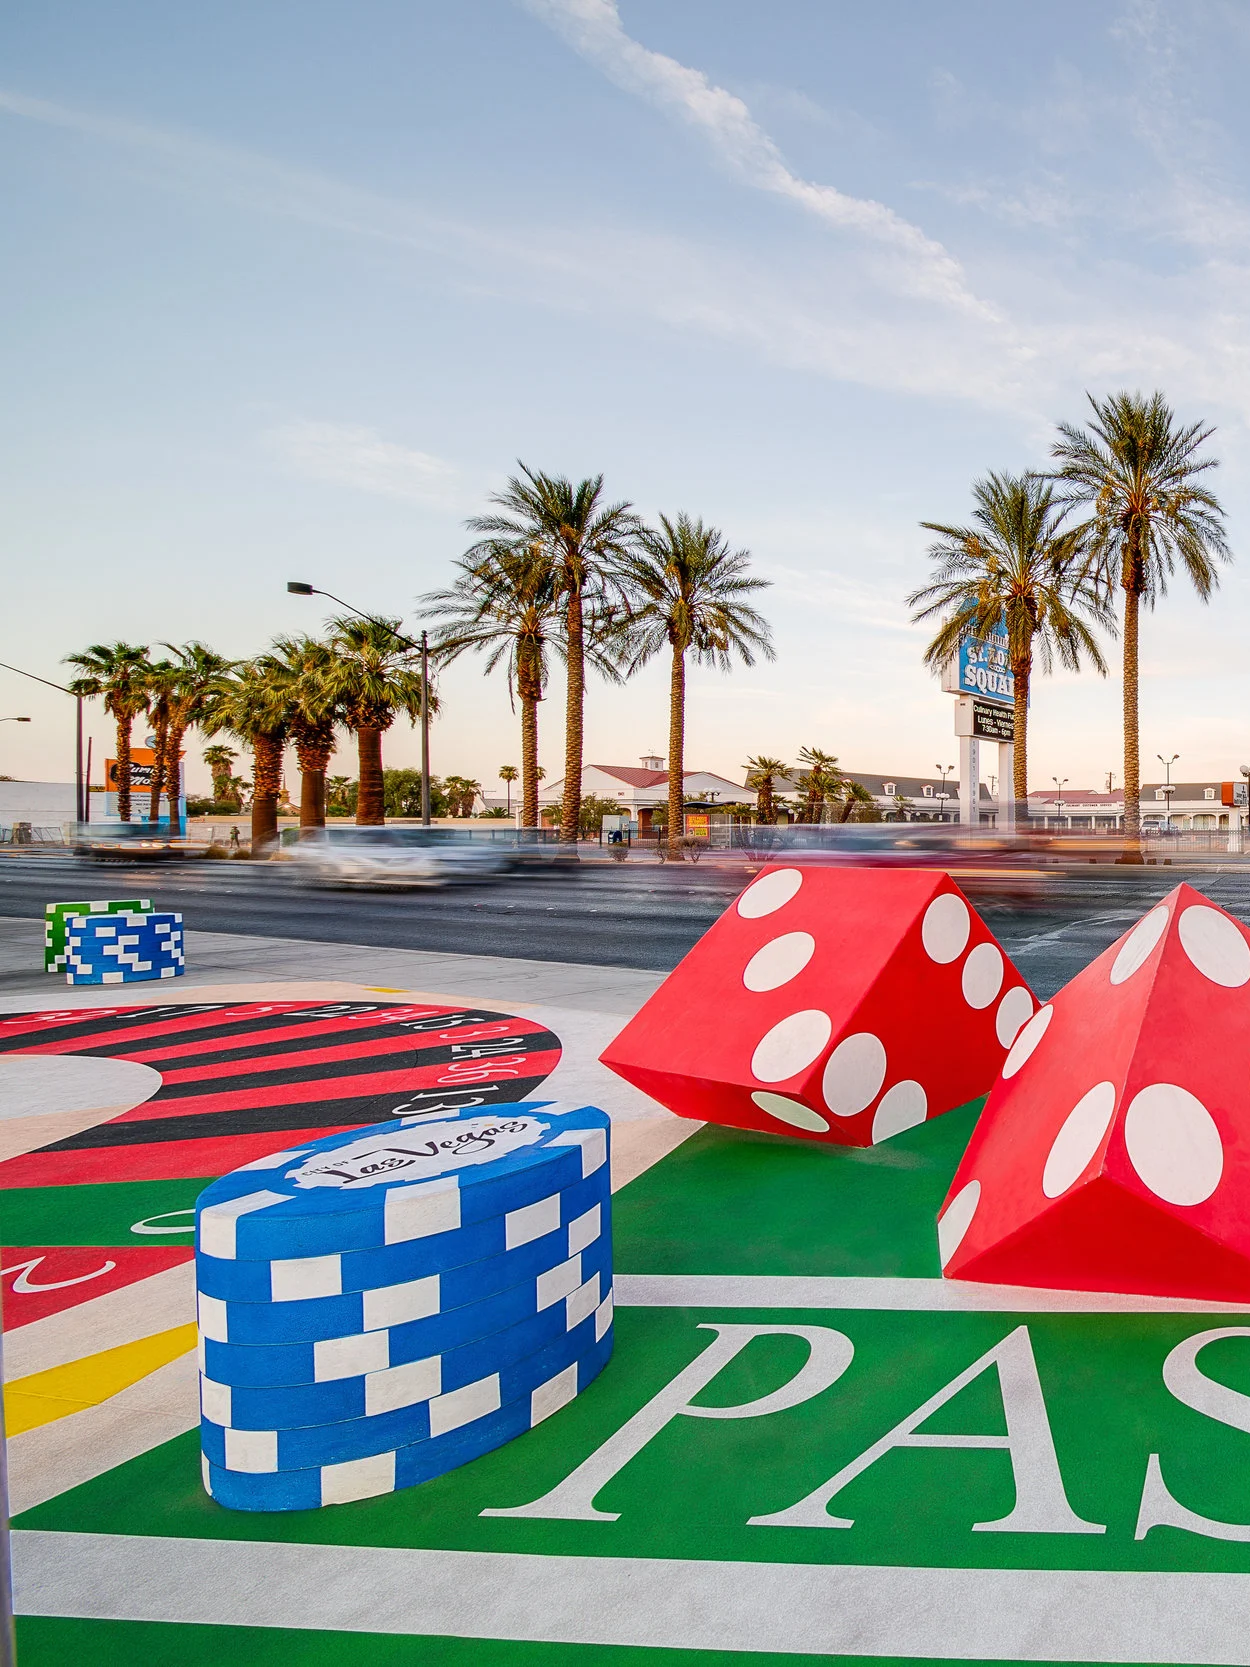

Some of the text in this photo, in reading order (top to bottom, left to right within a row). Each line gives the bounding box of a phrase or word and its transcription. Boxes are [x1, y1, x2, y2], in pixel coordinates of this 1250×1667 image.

[964, 664, 1014, 697] SQUA
[973, 704, 992, 717] Culinary
[992, 708, 1007, 719] Health
[977, 715, 993, 726] Lunes
[439, 1026, 510, 1039] 3
[451, 1037, 527, 1061] 24
[436, 1057, 527, 1084] 36
[391, 1084, 499, 1116] 13
[322, 1120, 528, 1184] Las Vegas
